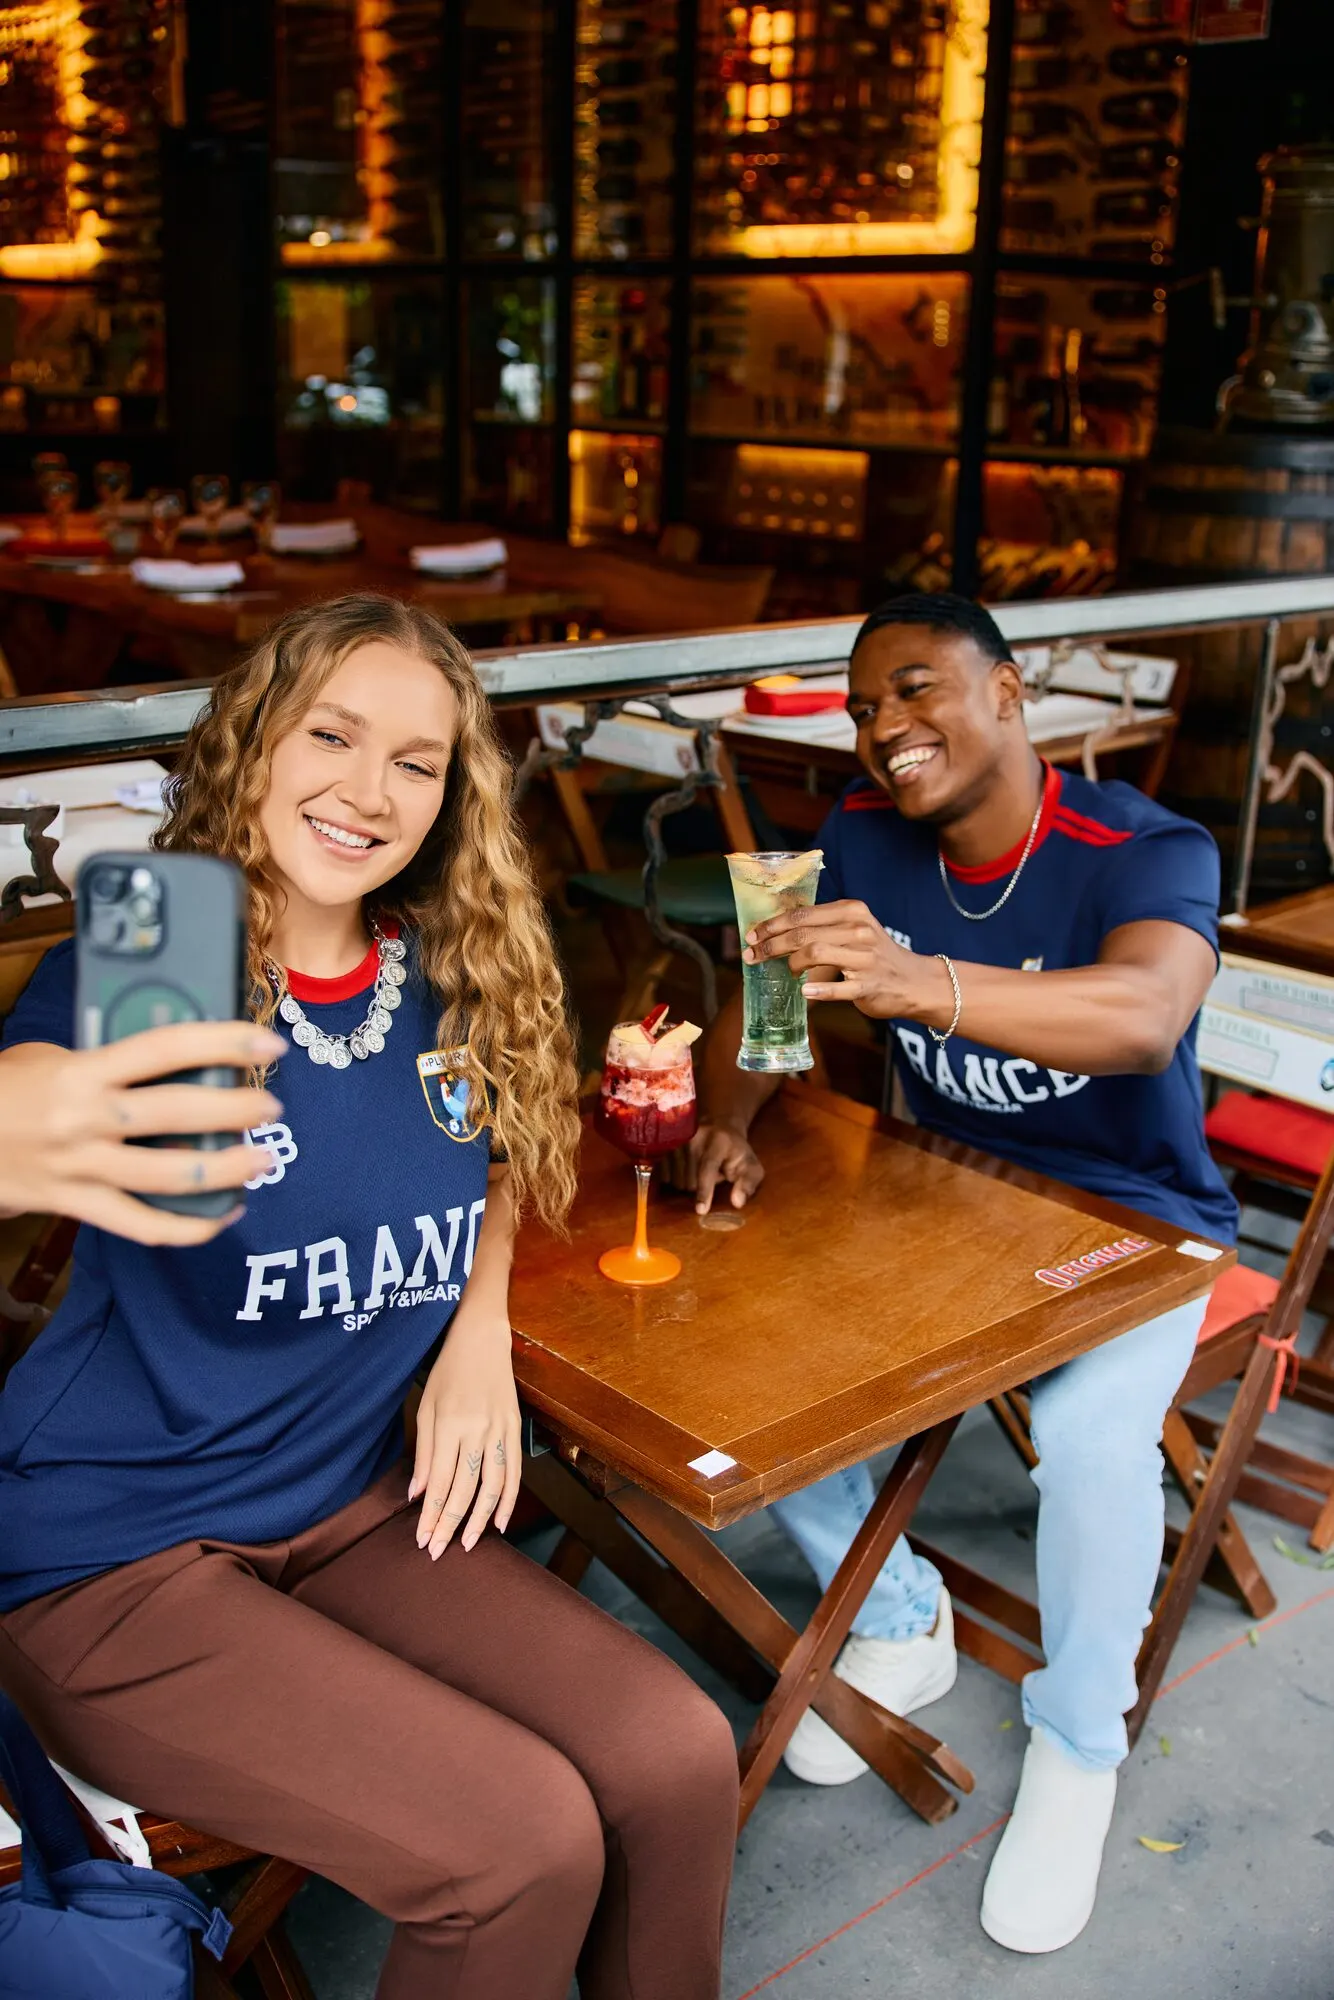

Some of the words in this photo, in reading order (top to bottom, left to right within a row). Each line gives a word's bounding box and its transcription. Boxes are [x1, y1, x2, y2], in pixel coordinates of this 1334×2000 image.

[892, 1025, 1091, 1103] RANCE
[1034, 1237, 1152, 1289] ORIGINAL
[343, 1284, 461, 1331] SPY&WEAR
